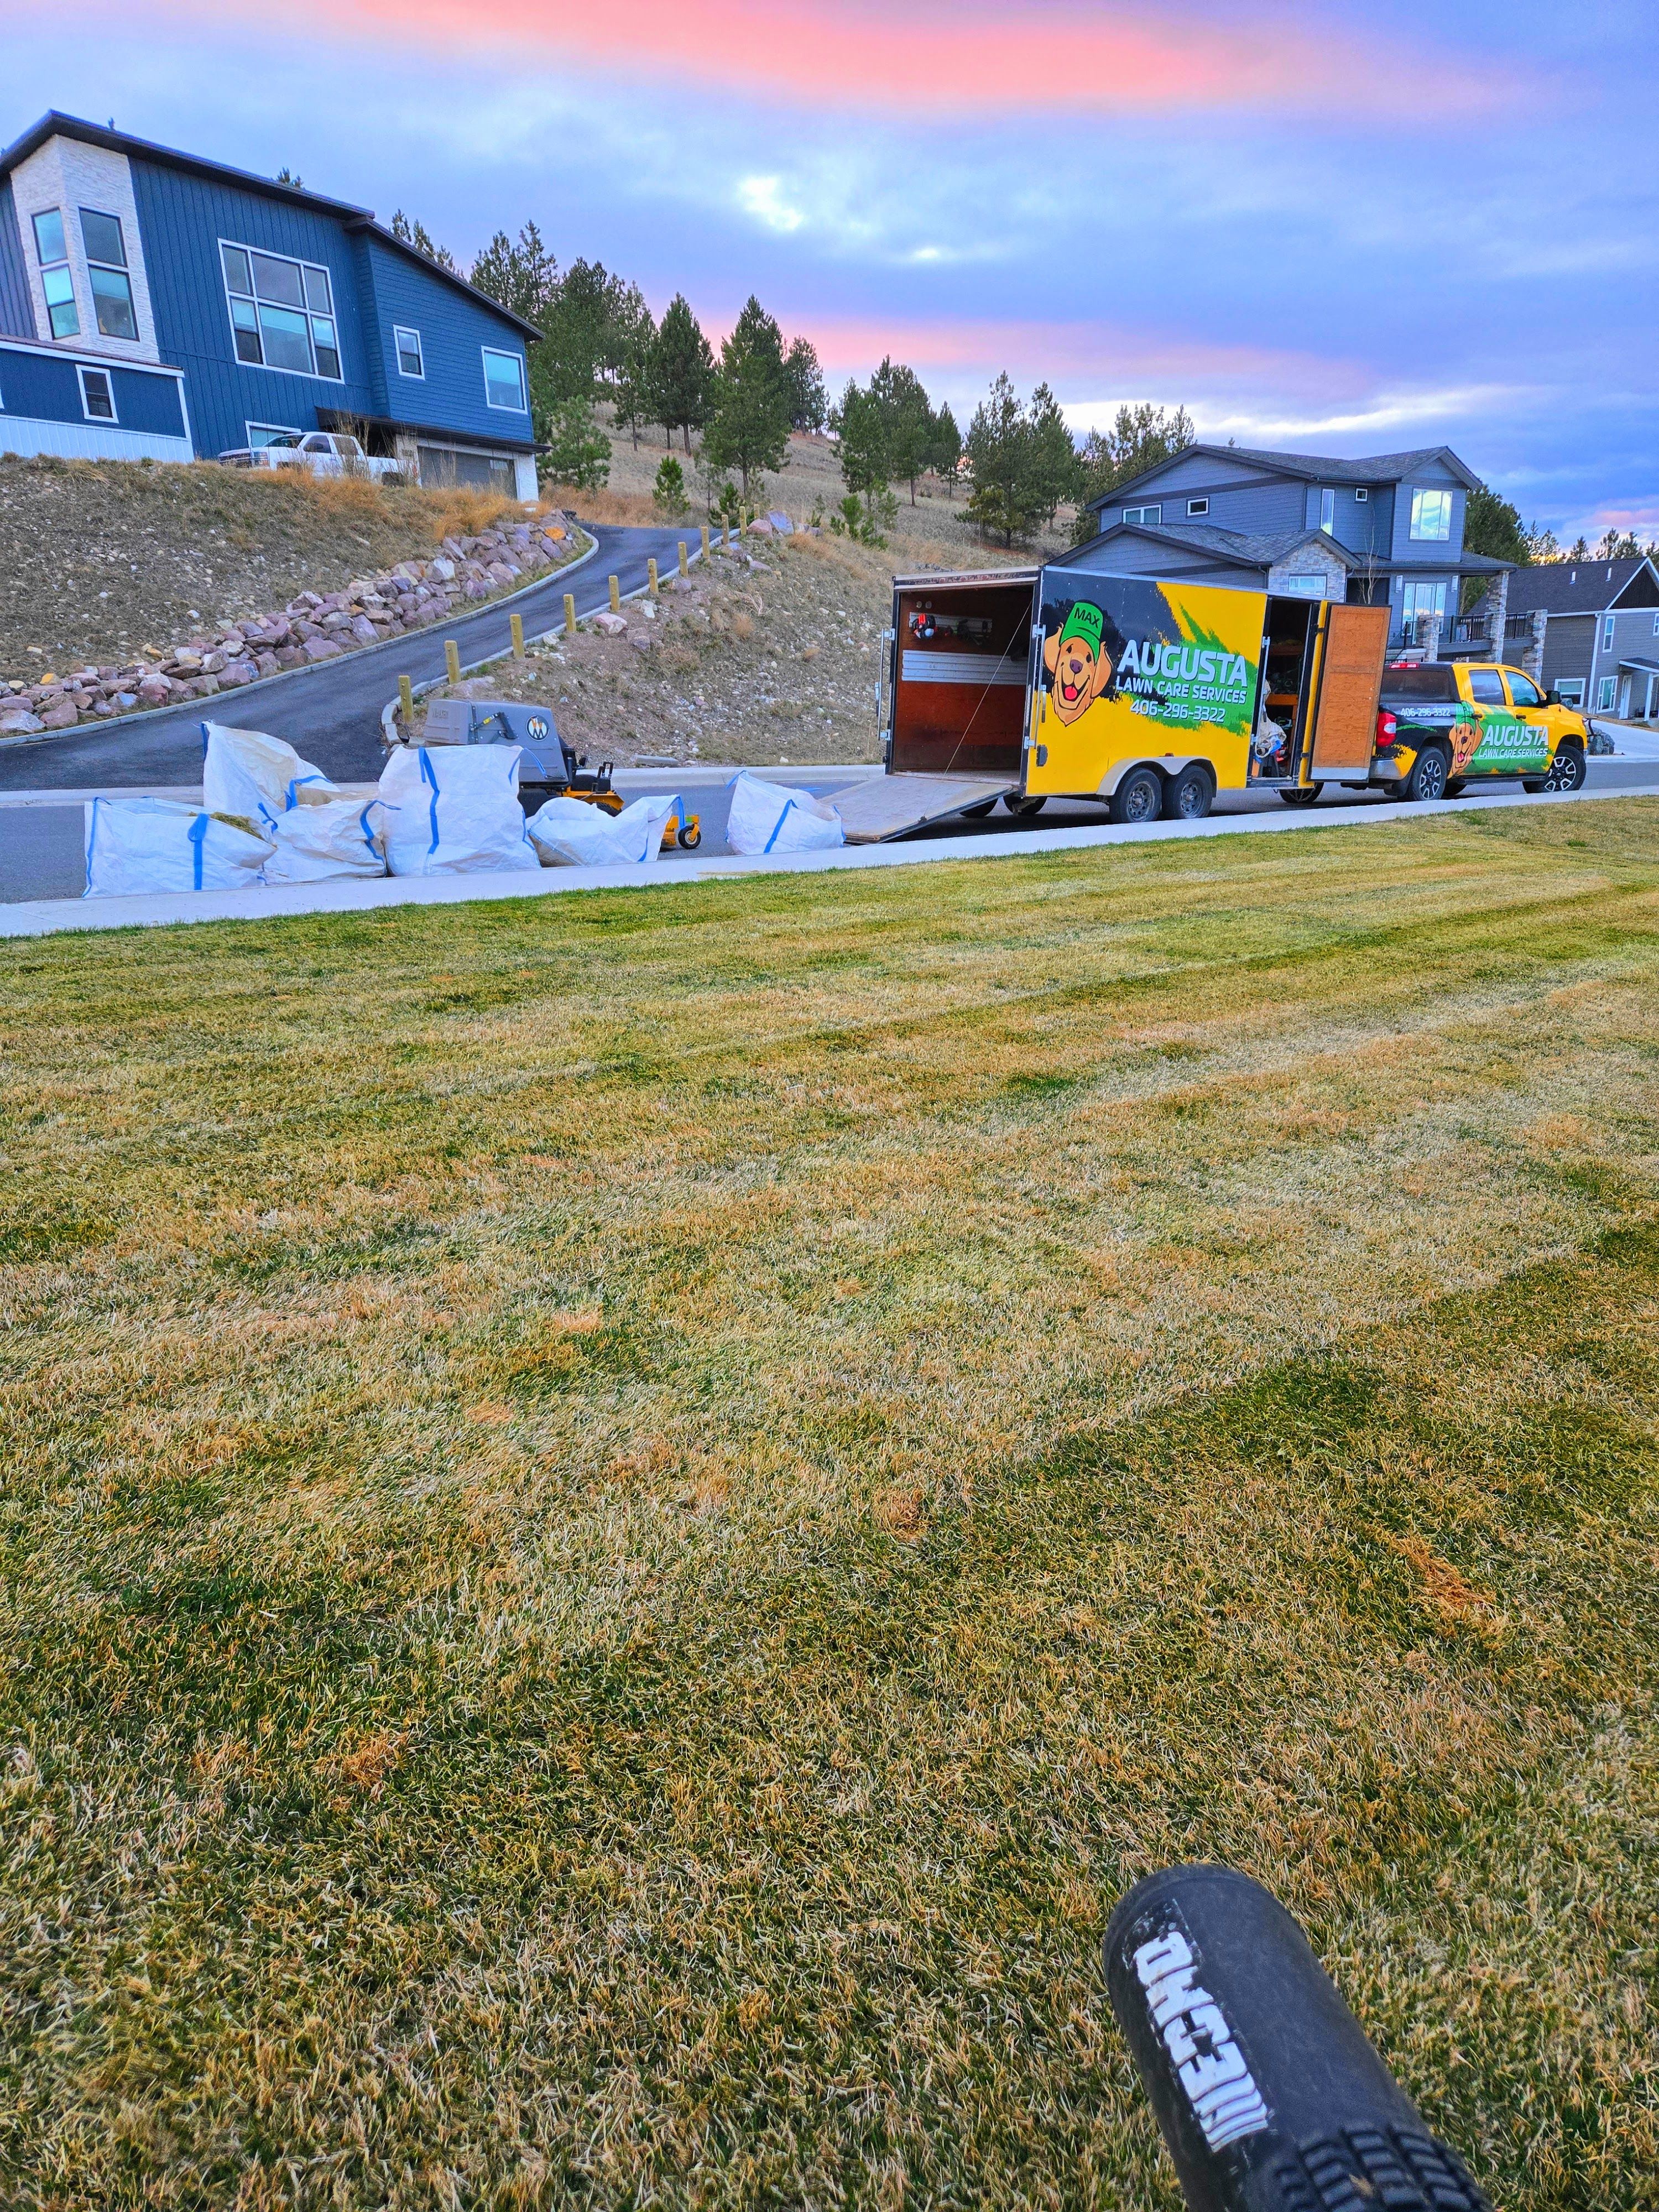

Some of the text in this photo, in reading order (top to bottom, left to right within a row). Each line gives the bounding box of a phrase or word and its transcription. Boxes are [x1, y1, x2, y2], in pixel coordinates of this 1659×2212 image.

[1074, 607, 1100, 629] MAX
[1117, 639, 1248, 687] AUGUSTA
[1116, 675, 1248, 704] LAWN CARE SERVICES
[1130, 699, 1226, 723] 406-296-3322
[1400, 707, 1451, 717] 406-296-3322
[1481, 724, 1548, 747] AUGUSTA
[1478, 748, 1548, 758] LAWN CARE SERVICES
[1133, 1931, 1248, 2102] ECHO
